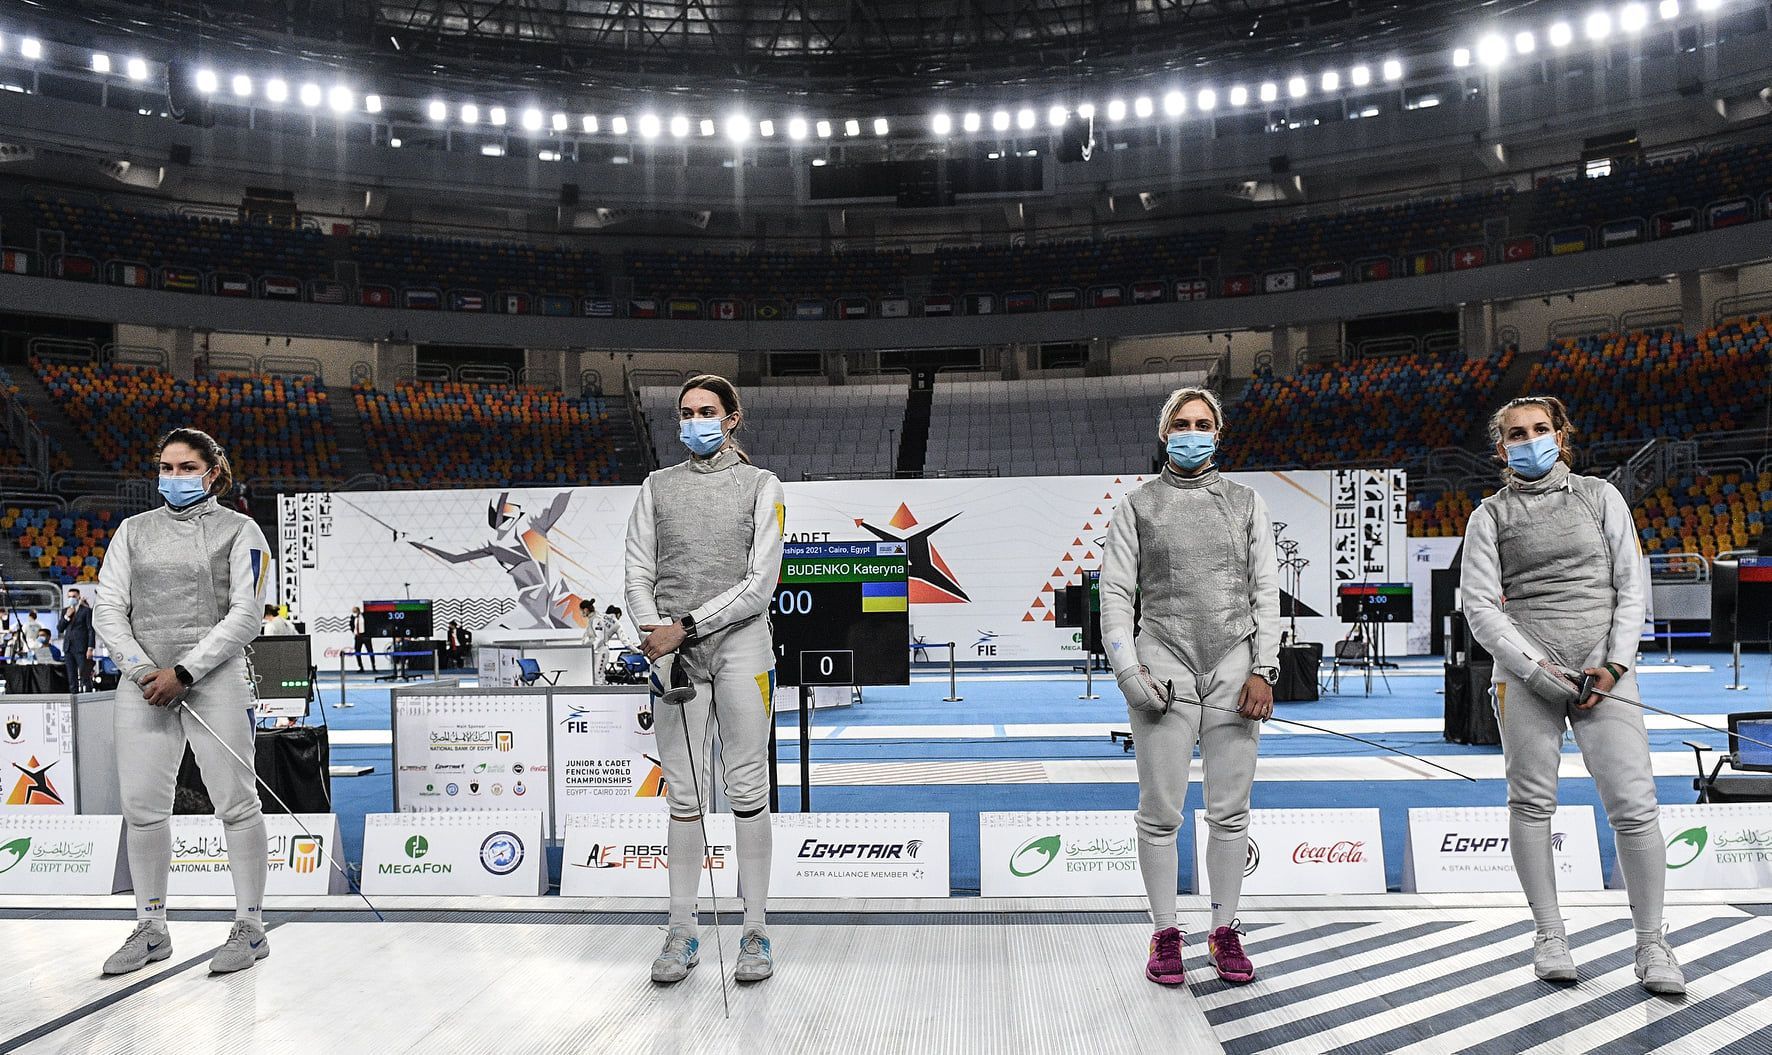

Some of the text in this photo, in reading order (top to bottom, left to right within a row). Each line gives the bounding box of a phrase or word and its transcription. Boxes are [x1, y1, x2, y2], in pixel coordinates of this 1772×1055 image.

[806, 546, 822, 554] 2021
[828, 546, 849, 554] Cairo,
[851, 545, 870, 555] Egypt
[787, 563, 905, 577] BUDENKO Kateryna
[1368, 595, 1387, 604] 3:00
[387, 612, 405, 620] 3:00
[778, 644, 785, 656] 1
[977, 645, 997, 656] FIE
[820, 656, 833, 676] 0
[567, 721, 588, 733] FIE
[565, 759, 631, 767] JUNIOR & CADET
[565, 768, 631, 776] FENCING WORLD
[566, 788, 587, 796] EGYPT
[593, 788, 614, 796] CAIRO
[615, 788, 631, 796] 2021
[1440, 833, 1510, 852] EGYPT
[797, 839, 904, 859] EGYPTAIR
[1716, 852, 1753, 864] EGYPT
[30, 863, 91, 873] EGYPT POST
[1066, 860, 1137, 872] EGYPT POST
[1449, 864, 1471, 872] STAR
[1473, 864, 1516, 872] ALLIANCE
[796, 870, 908, 878] A STAR ALLIANCE MEMBER
